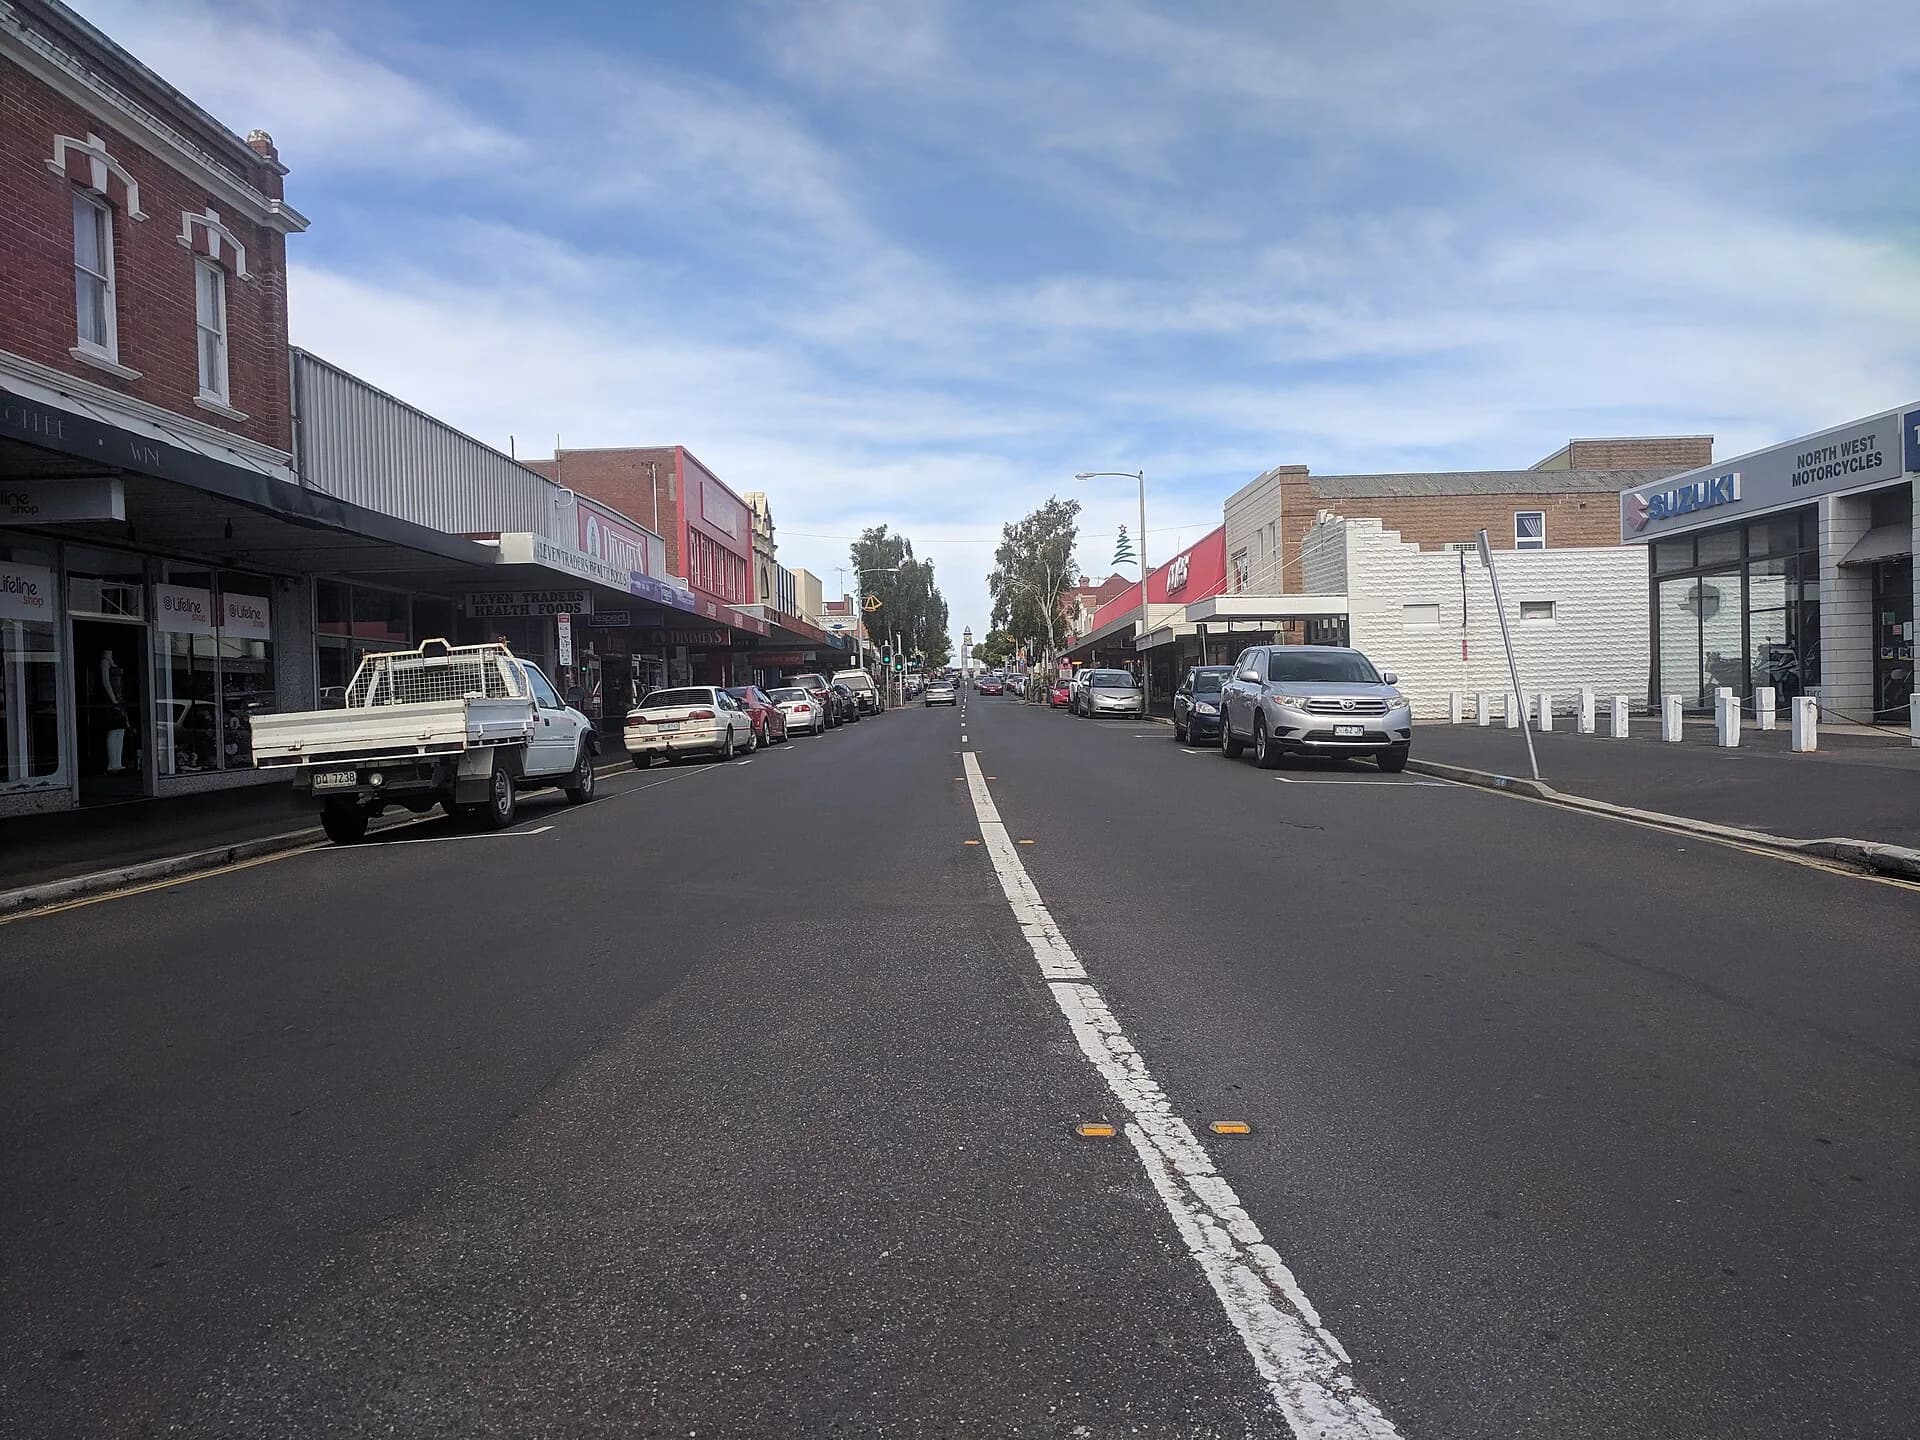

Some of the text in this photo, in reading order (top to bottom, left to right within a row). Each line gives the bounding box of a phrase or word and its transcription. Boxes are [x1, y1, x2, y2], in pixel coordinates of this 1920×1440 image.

[1797, 434, 1876, 469] NORTH WEST
[1792, 451, 1883, 487] MOTORCYCLES
[1649, 472, 1741, 520] SUZUKI
[10, 504, 39, 515] shop
[539, 541, 561, 562] LEVEN
[561, 549, 589, 573] TRADERS
[0, 575, 38, 595] ifeline
[173, 596, 202, 614] Lifeline
[472, 591, 584, 605] LEVEN TRADERS
[236, 604, 262, 620] Lifeline
[475, 603, 582, 616] HEALTH FOODS
[670, 628, 722, 644] DIMMEYS
